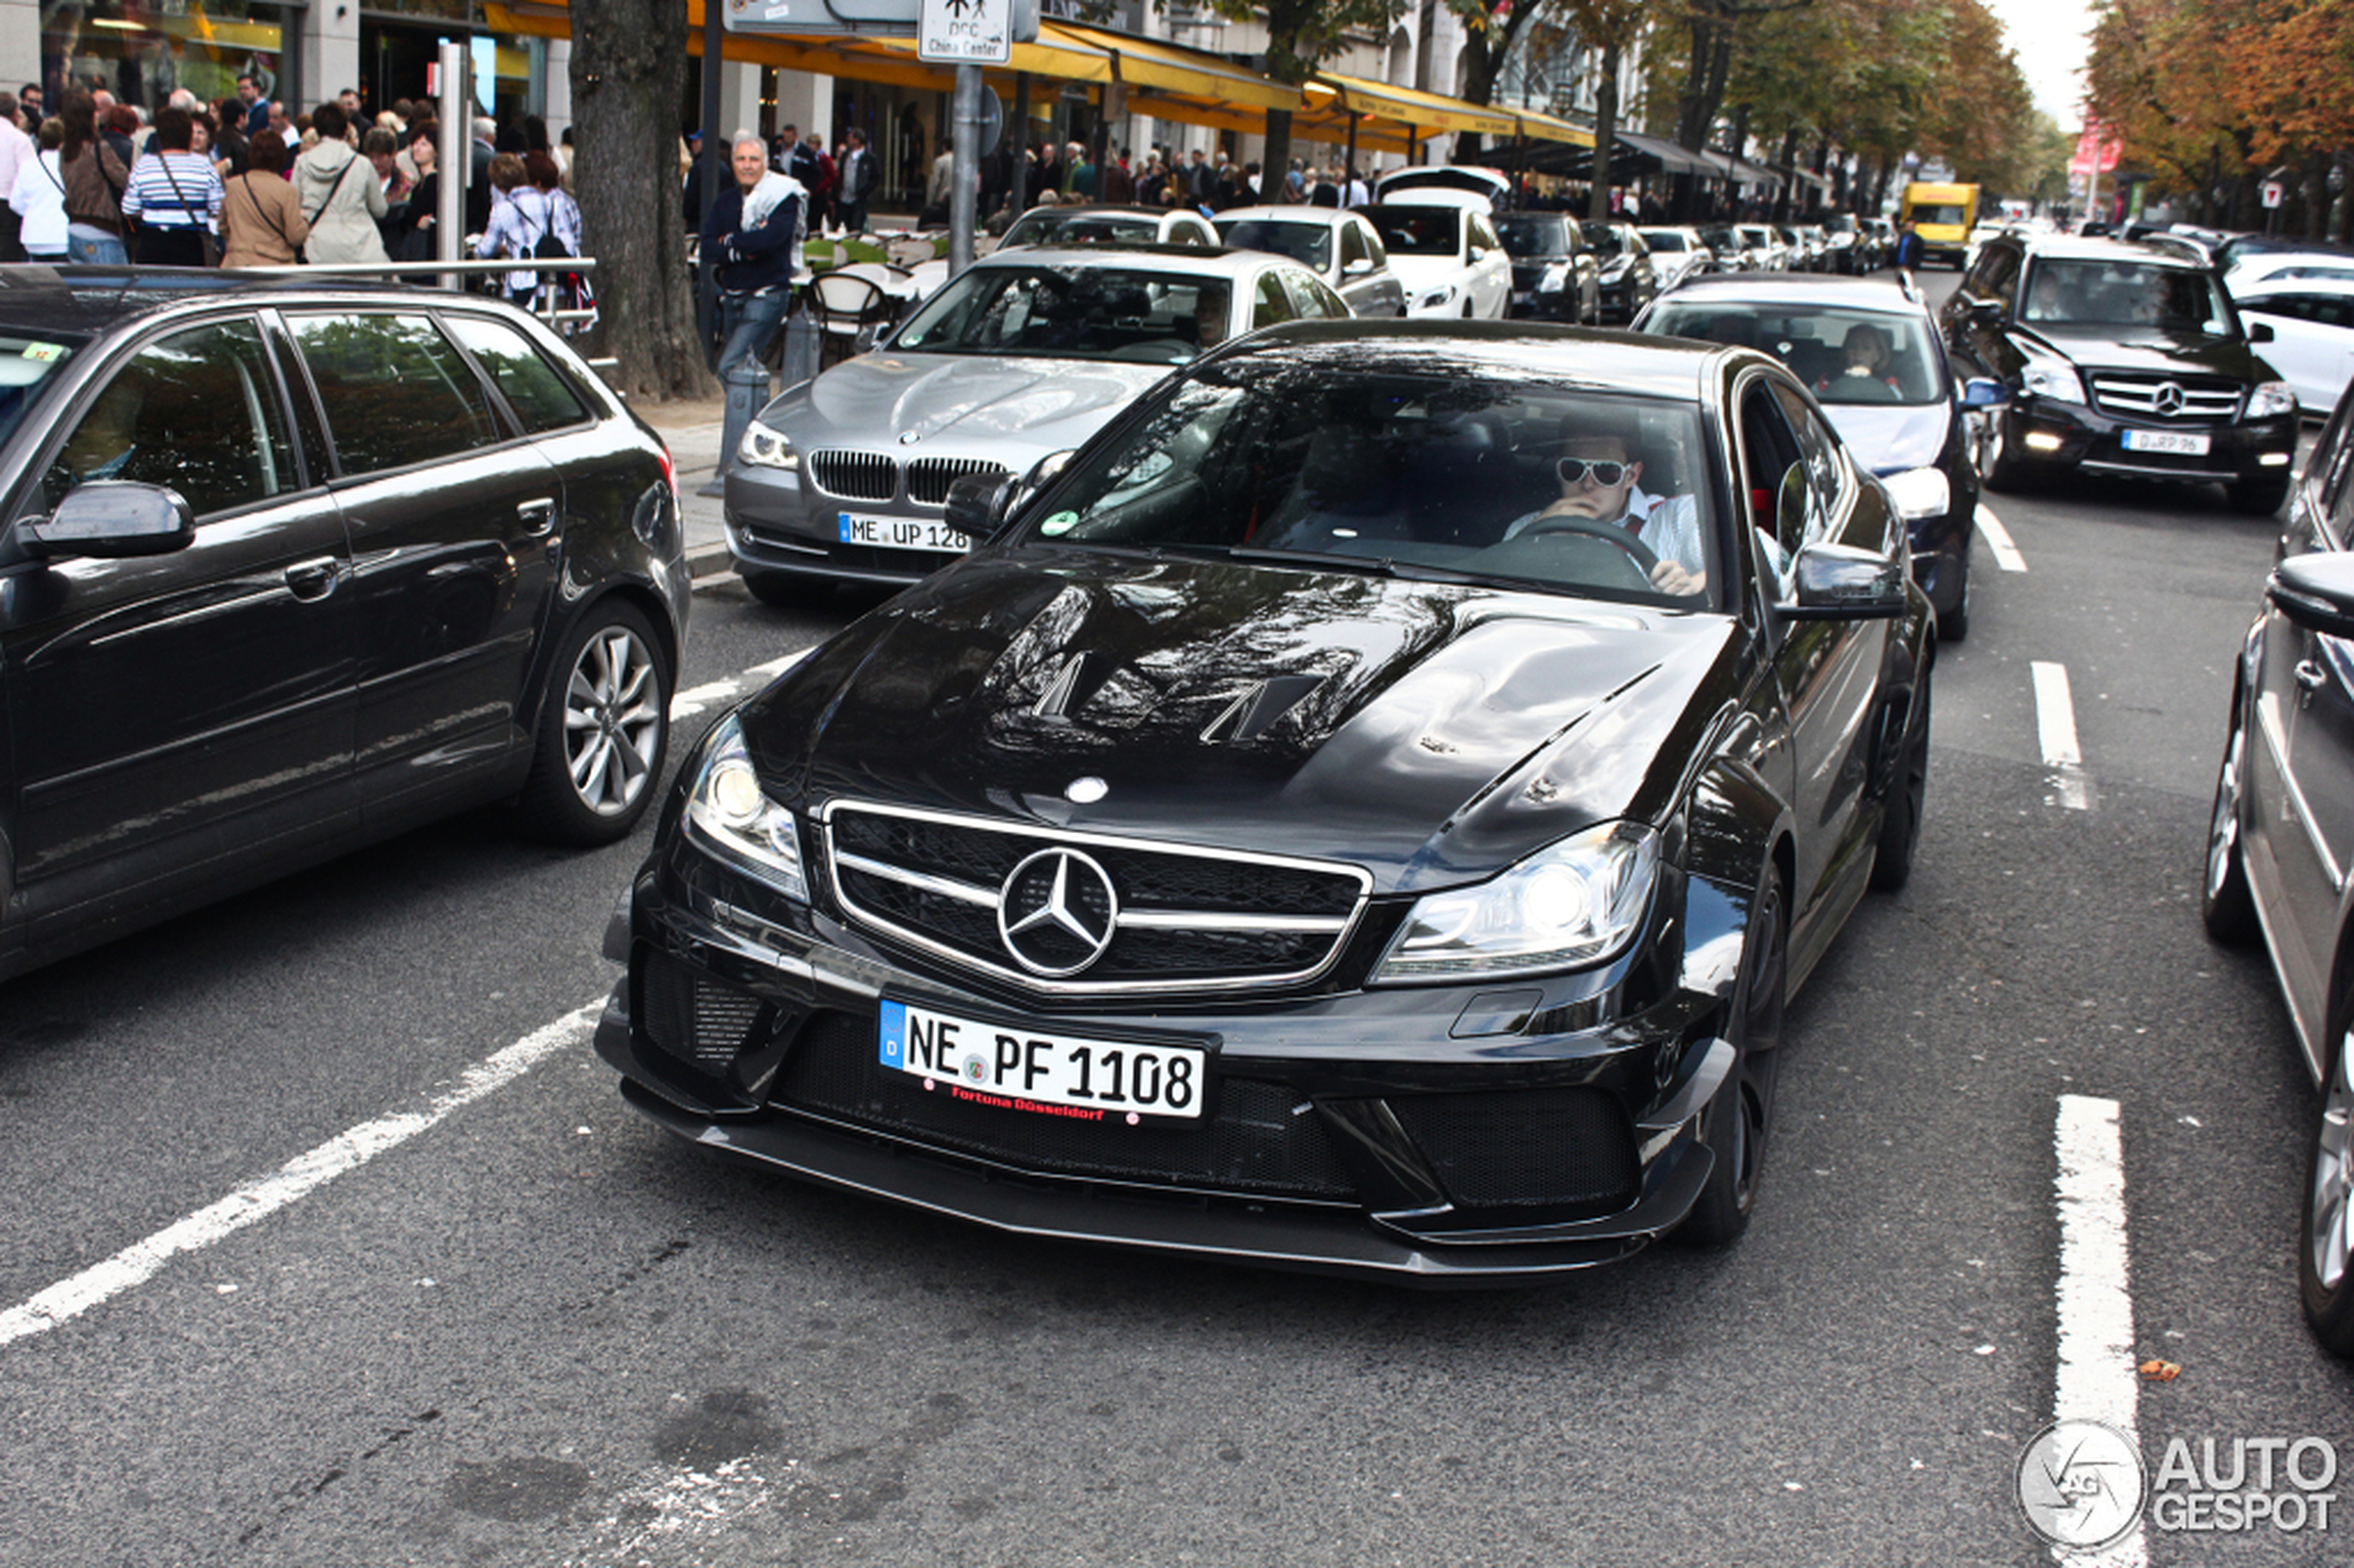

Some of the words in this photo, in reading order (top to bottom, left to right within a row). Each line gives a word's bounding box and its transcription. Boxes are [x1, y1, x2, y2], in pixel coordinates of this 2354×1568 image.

[929, 38, 958, 54] China
[963, 41, 998, 56] Center
[852, 520, 879, 542] ME
[893, 524, 921, 545] UP
[886, 1040, 897, 1056] D
[908, 1014, 961, 1076] NE
[994, 1034, 1054, 1090] PF
[1067, 1047, 1194, 1108] 1108
[951, 1086, 1012, 1107] Fortuna
[1015, 1098, 1105, 1121] Düsseldorf
